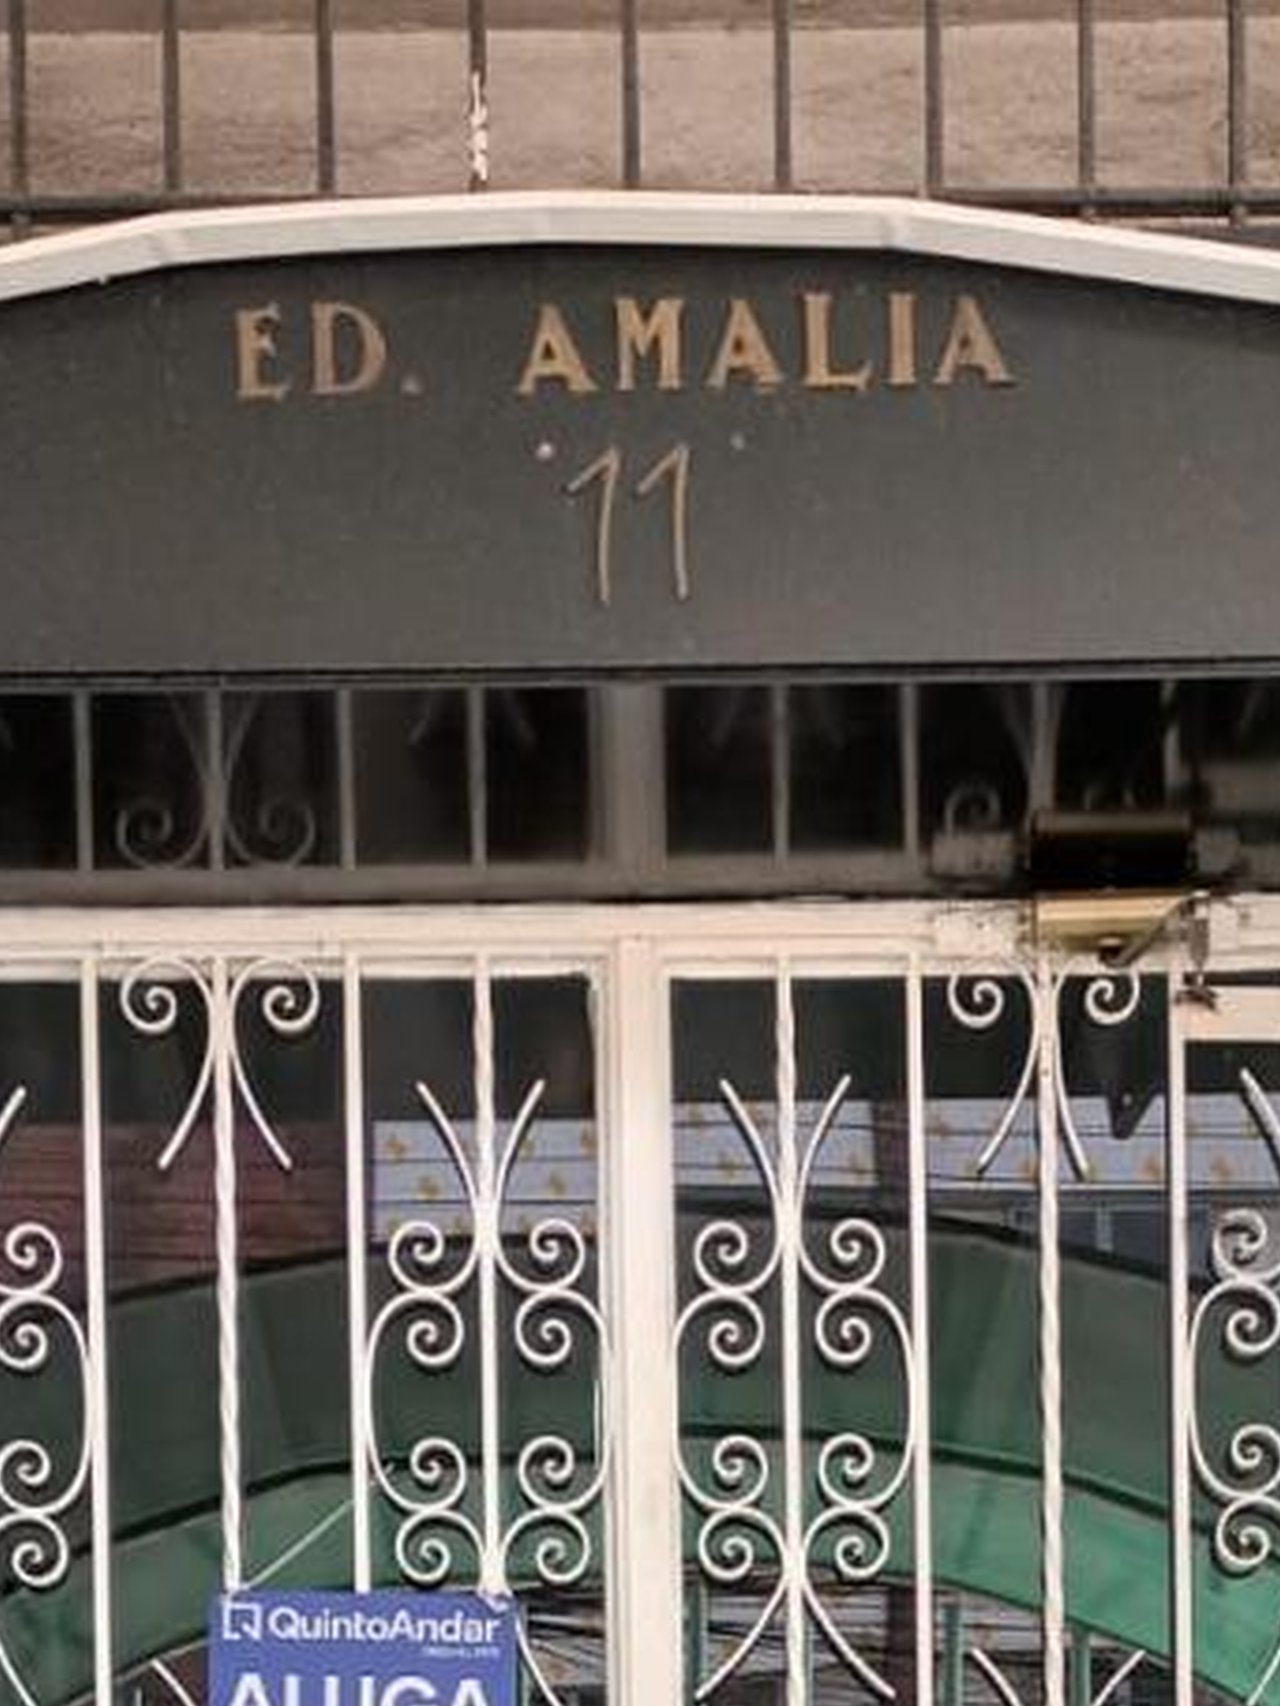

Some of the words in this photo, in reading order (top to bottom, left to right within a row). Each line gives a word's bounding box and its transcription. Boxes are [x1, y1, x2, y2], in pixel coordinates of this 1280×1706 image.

[233, 301, 424, 400] ED.
[519, 291, 1015, 394] AMALIA
[566, 443, 691, 602] 11
[268, 1606, 500, 1643] QuintoAndar
